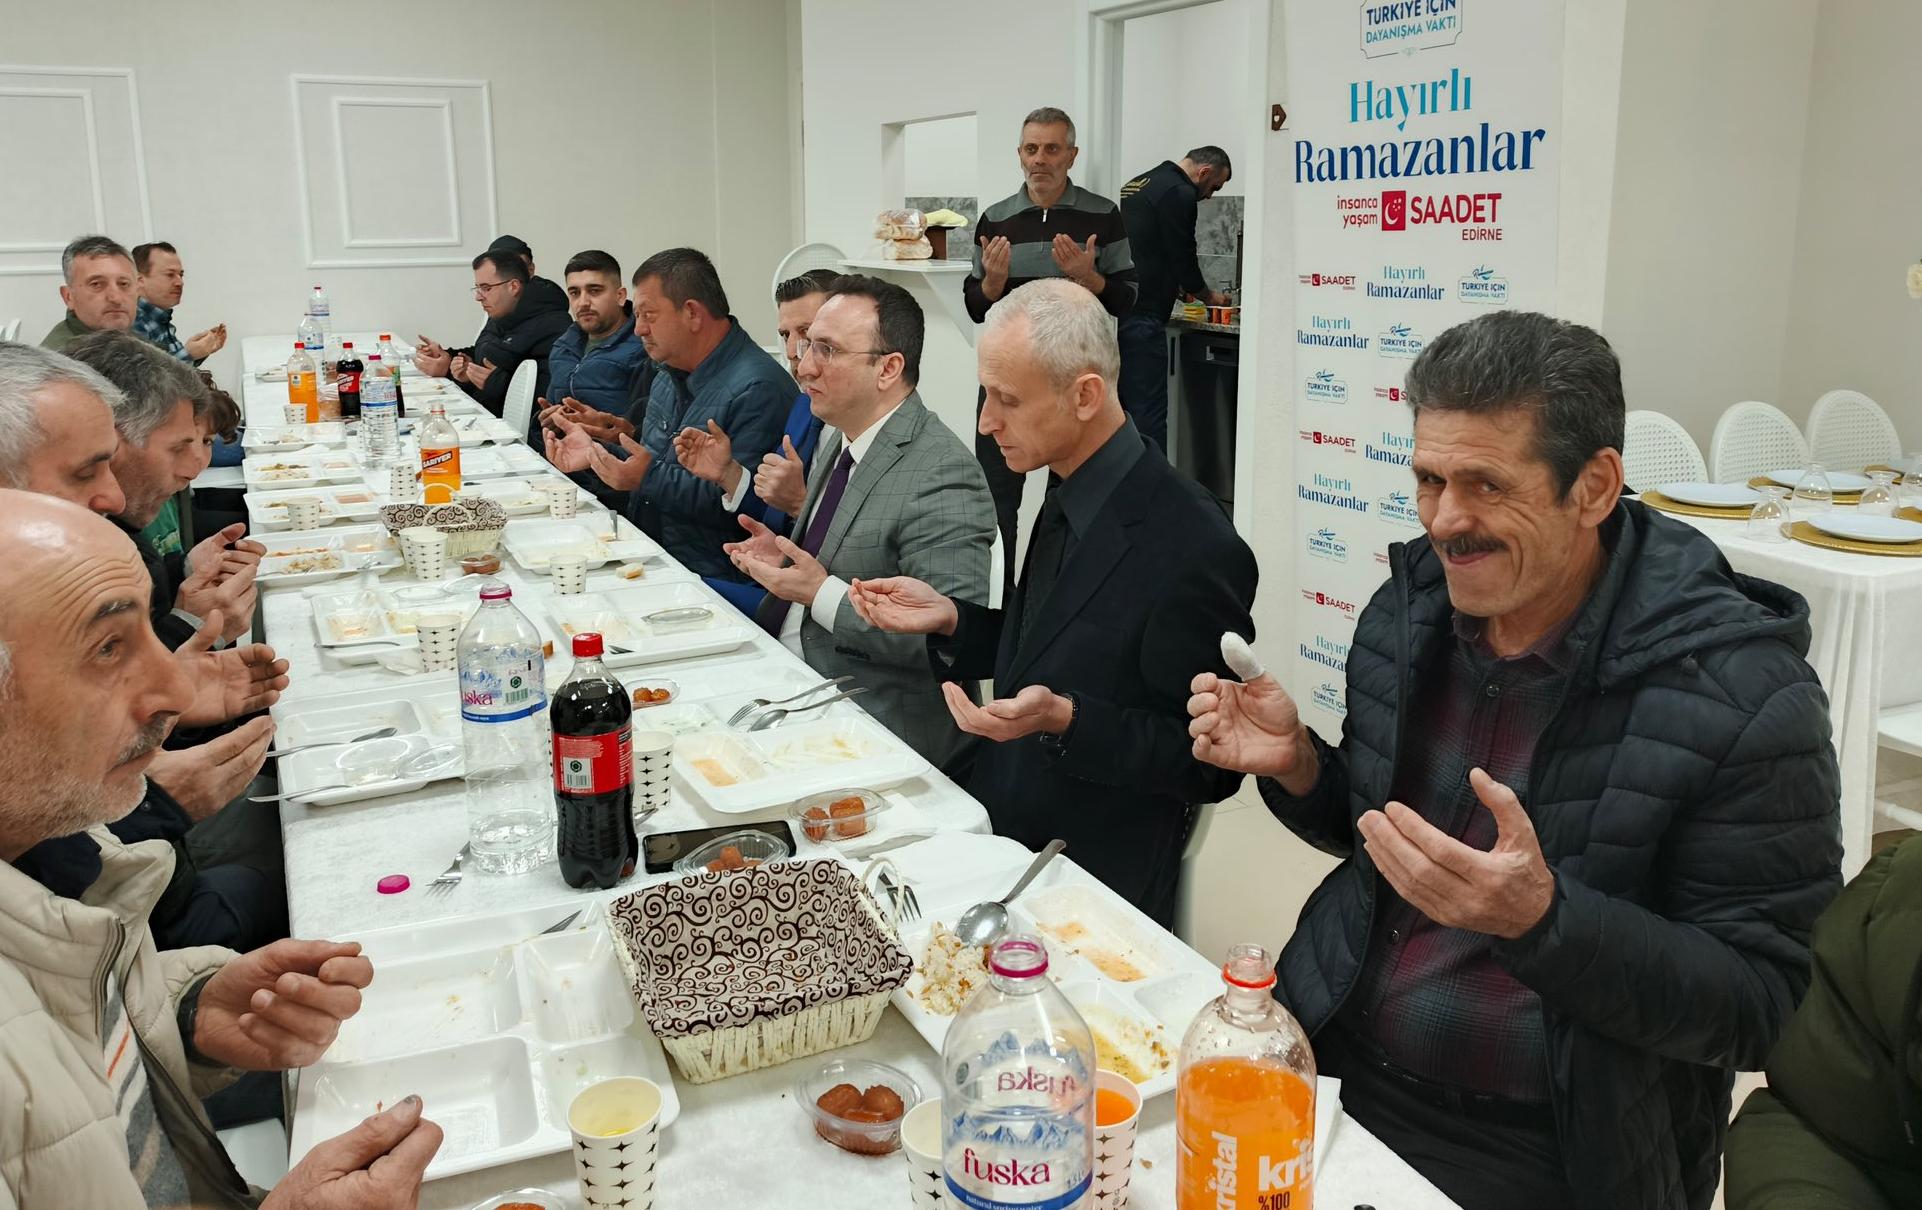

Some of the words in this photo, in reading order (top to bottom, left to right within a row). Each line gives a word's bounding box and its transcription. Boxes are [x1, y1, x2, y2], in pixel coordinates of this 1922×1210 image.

[1366, 24, 1423, 44] DAYANIŞMA
[1349, 68, 1472, 132] Hayırlı
[1295, 122, 1546, 183] Ramazanlar
[1337, 195, 1378, 210] insanca
[1410, 193, 1502, 224] SAADET
[1343, 210, 1378, 229] yaşam
[1462, 228, 1503, 241] EDİRNE
[1321, 275, 1356, 286] SAADET
[1366, 281, 1445, 301] Ramazanlar
[1297, 329, 1369, 349] Ramazanlar
[1322, 435, 1356, 447] SAADET
[1298, 484, 1369, 513] Ramazanlar
[1325, 597, 1355, 613] SAADET
[964, 1147, 1051, 1186] fuska
[1258, 1191, 1291, 1210] %100
